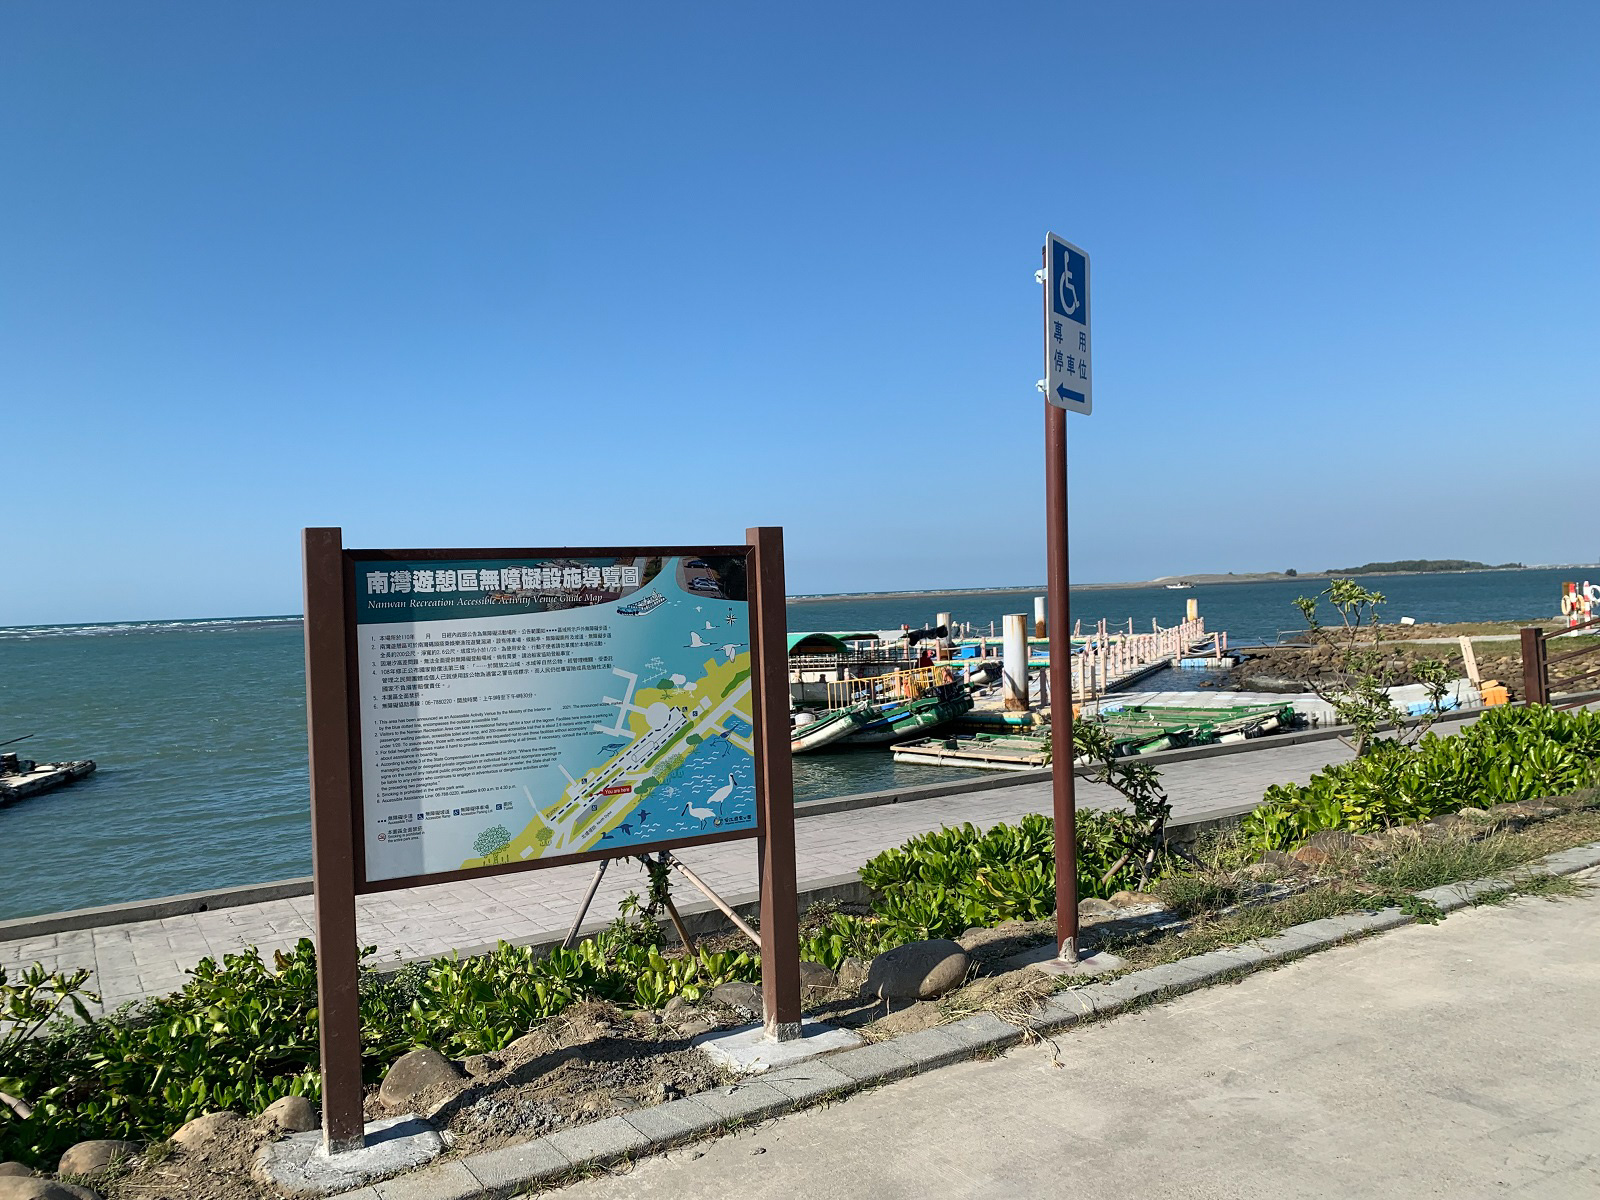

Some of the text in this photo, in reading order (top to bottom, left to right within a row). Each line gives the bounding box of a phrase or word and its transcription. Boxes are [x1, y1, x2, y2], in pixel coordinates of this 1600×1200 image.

[1054, 349, 1087, 380] 停車位
[368, 592, 603, 609] Nanwan Recreation Accessible Activity Venue Guide Map
